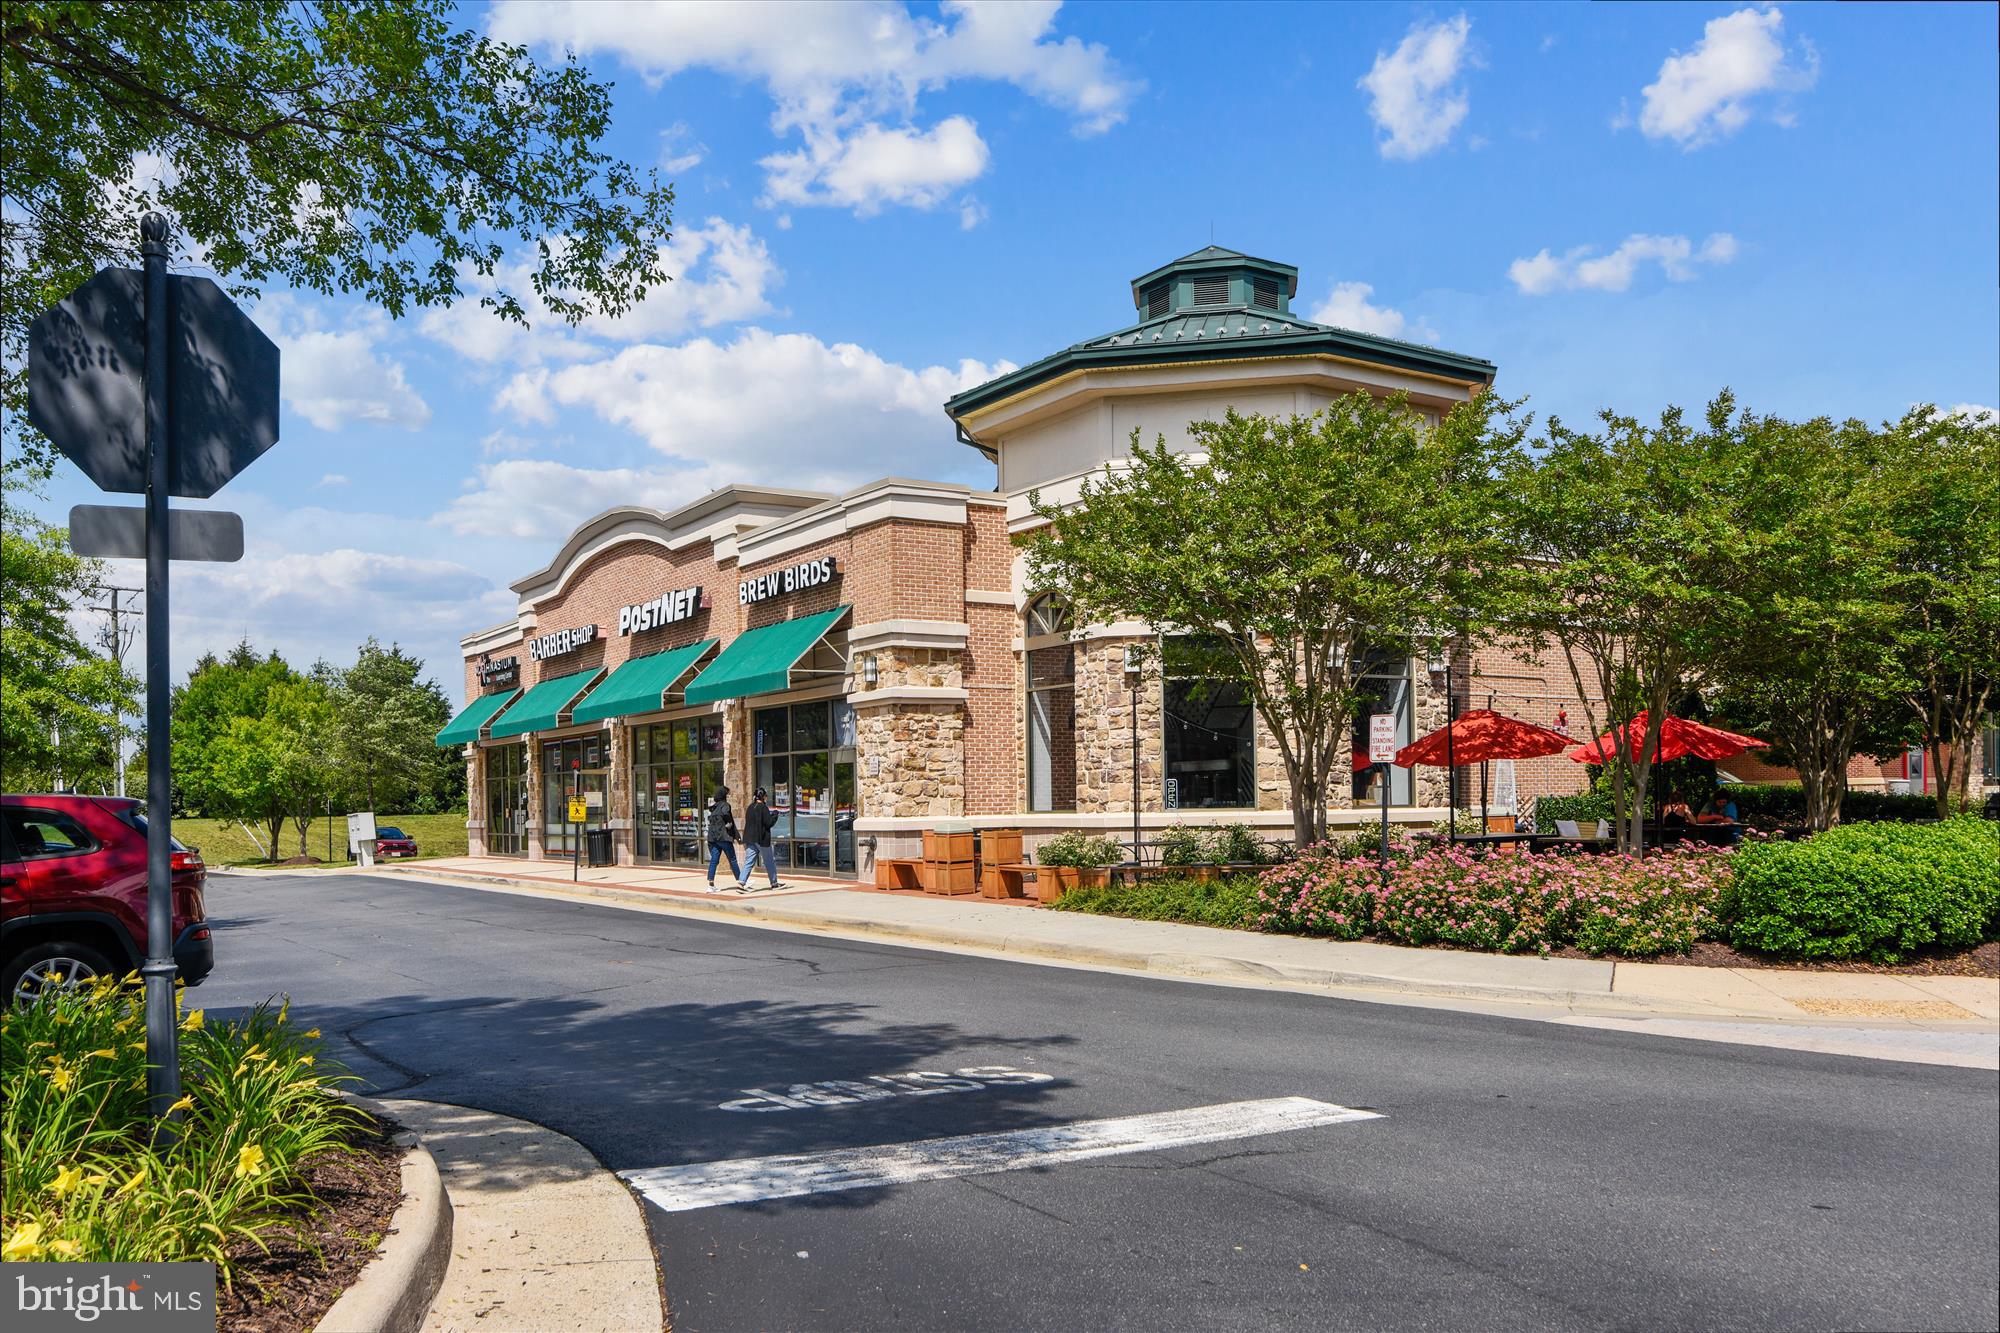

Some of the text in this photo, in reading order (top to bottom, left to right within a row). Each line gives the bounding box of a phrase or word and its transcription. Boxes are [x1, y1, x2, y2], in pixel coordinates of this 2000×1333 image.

[740, 557, 830, 604] BREW BIRDS
[529, 625, 593, 661] BARBER SHOP
[1382, 745, 1394, 753] LANE
[1168, 780, 1176, 808] OPEN
